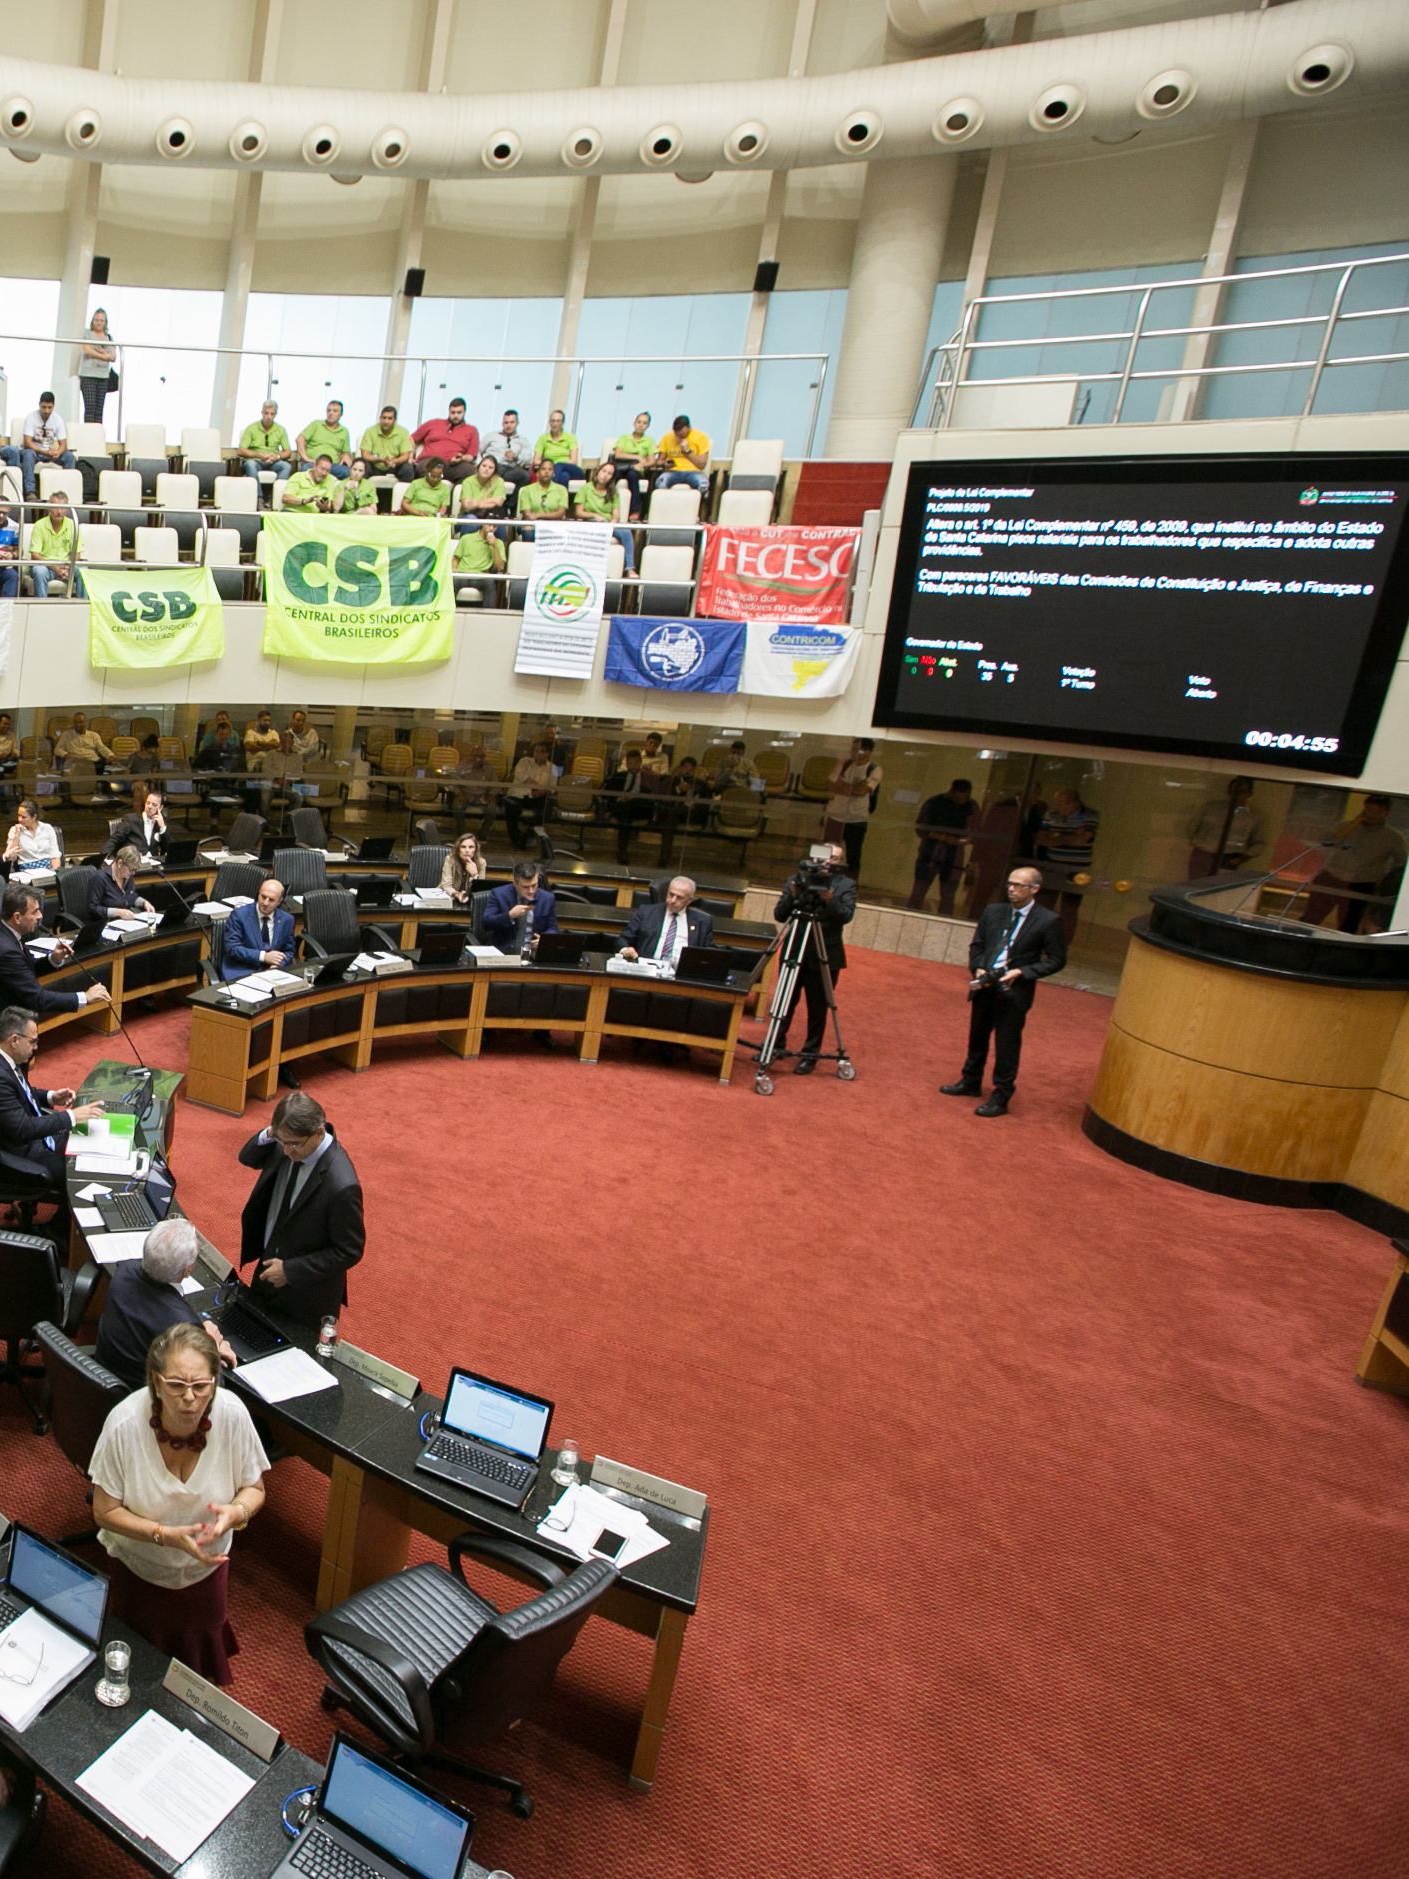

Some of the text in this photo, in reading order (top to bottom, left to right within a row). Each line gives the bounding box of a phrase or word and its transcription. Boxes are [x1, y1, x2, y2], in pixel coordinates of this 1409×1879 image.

[759, 530, 784, 538] CUT
[1025, 519, 1101, 533] Complementar
[1140, 520, 1157, 532] de
[1156, 520, 1189, 533] 2009,
[1191, 522, 1215, 535] que
[1254, 522, 1273, 533] no
[1273, 520, 1316, 534] âmbito
[1316, 521, 1336, 534] do
[1336, 521, 1385, 534] Estado
[938, 531, 967, 543] Santa
[967, 531, 1008, 543] Catarina
[1078, 535, 1105, 548] para
[1105, 536, 1120, 546] os
[1120, 534, 1197, 546] trabalhadores
[1197, 537, 1222, 549] que
[1222, 536, 1283, 550] especifica
[1283, 538, 1294, 548] e
[1294, 536, 1332, 549] adota
[1332, 537, 1375, 549] outras
[718, 536, 853, 582] FECESC
[283, 541, 440, 608] CSB
[918, 568, 942, 581] Com
[990, 570, 1059, 584] FAVORÁVEIS
[1059, 574, 1080, 585] das
[1080, 573, 1140, 587] Comissões
[1140, 576, 1156, 588] de
[1156, 576, 1226, 593] Constituição
[1226, 580, 1237, 591] e
[1236, 579, 1283, 594] Justiça,
[1283, 580, 1303, 593] de
[1303, 581, 1362, 597] Finanças
[1362, 585, 1374, 595] e
[973, 583, 988, 595] de
[988, 584, 1032, 597] Trabalho
[760, 594, 777, 603] dos
[111, 591, 197, 623] CSB
[713, 606, 741, 618] Estado
[774, 603, 786, 612] no
[284, 607, 440, 624] CENTRAL DOS SINDICATOS
[159, 622, 198, 631] SINDICATOS
[324, 626, 399, 638] BRASILEIROS
[136, 632, 175, 640] BRASILEIROS
[771, 634, 836, 645] CONTRICOM
[1244, 730, 1340, 753] 00:04:55
[349, 1357, 360, 1368] Dep.
[362, 1364, 378, 1377] Moacir
[617, 1477, 677, 1505] Dep. Ada de Luca
[186, 1689, 249, 1739] Dep. Romildo Titon
